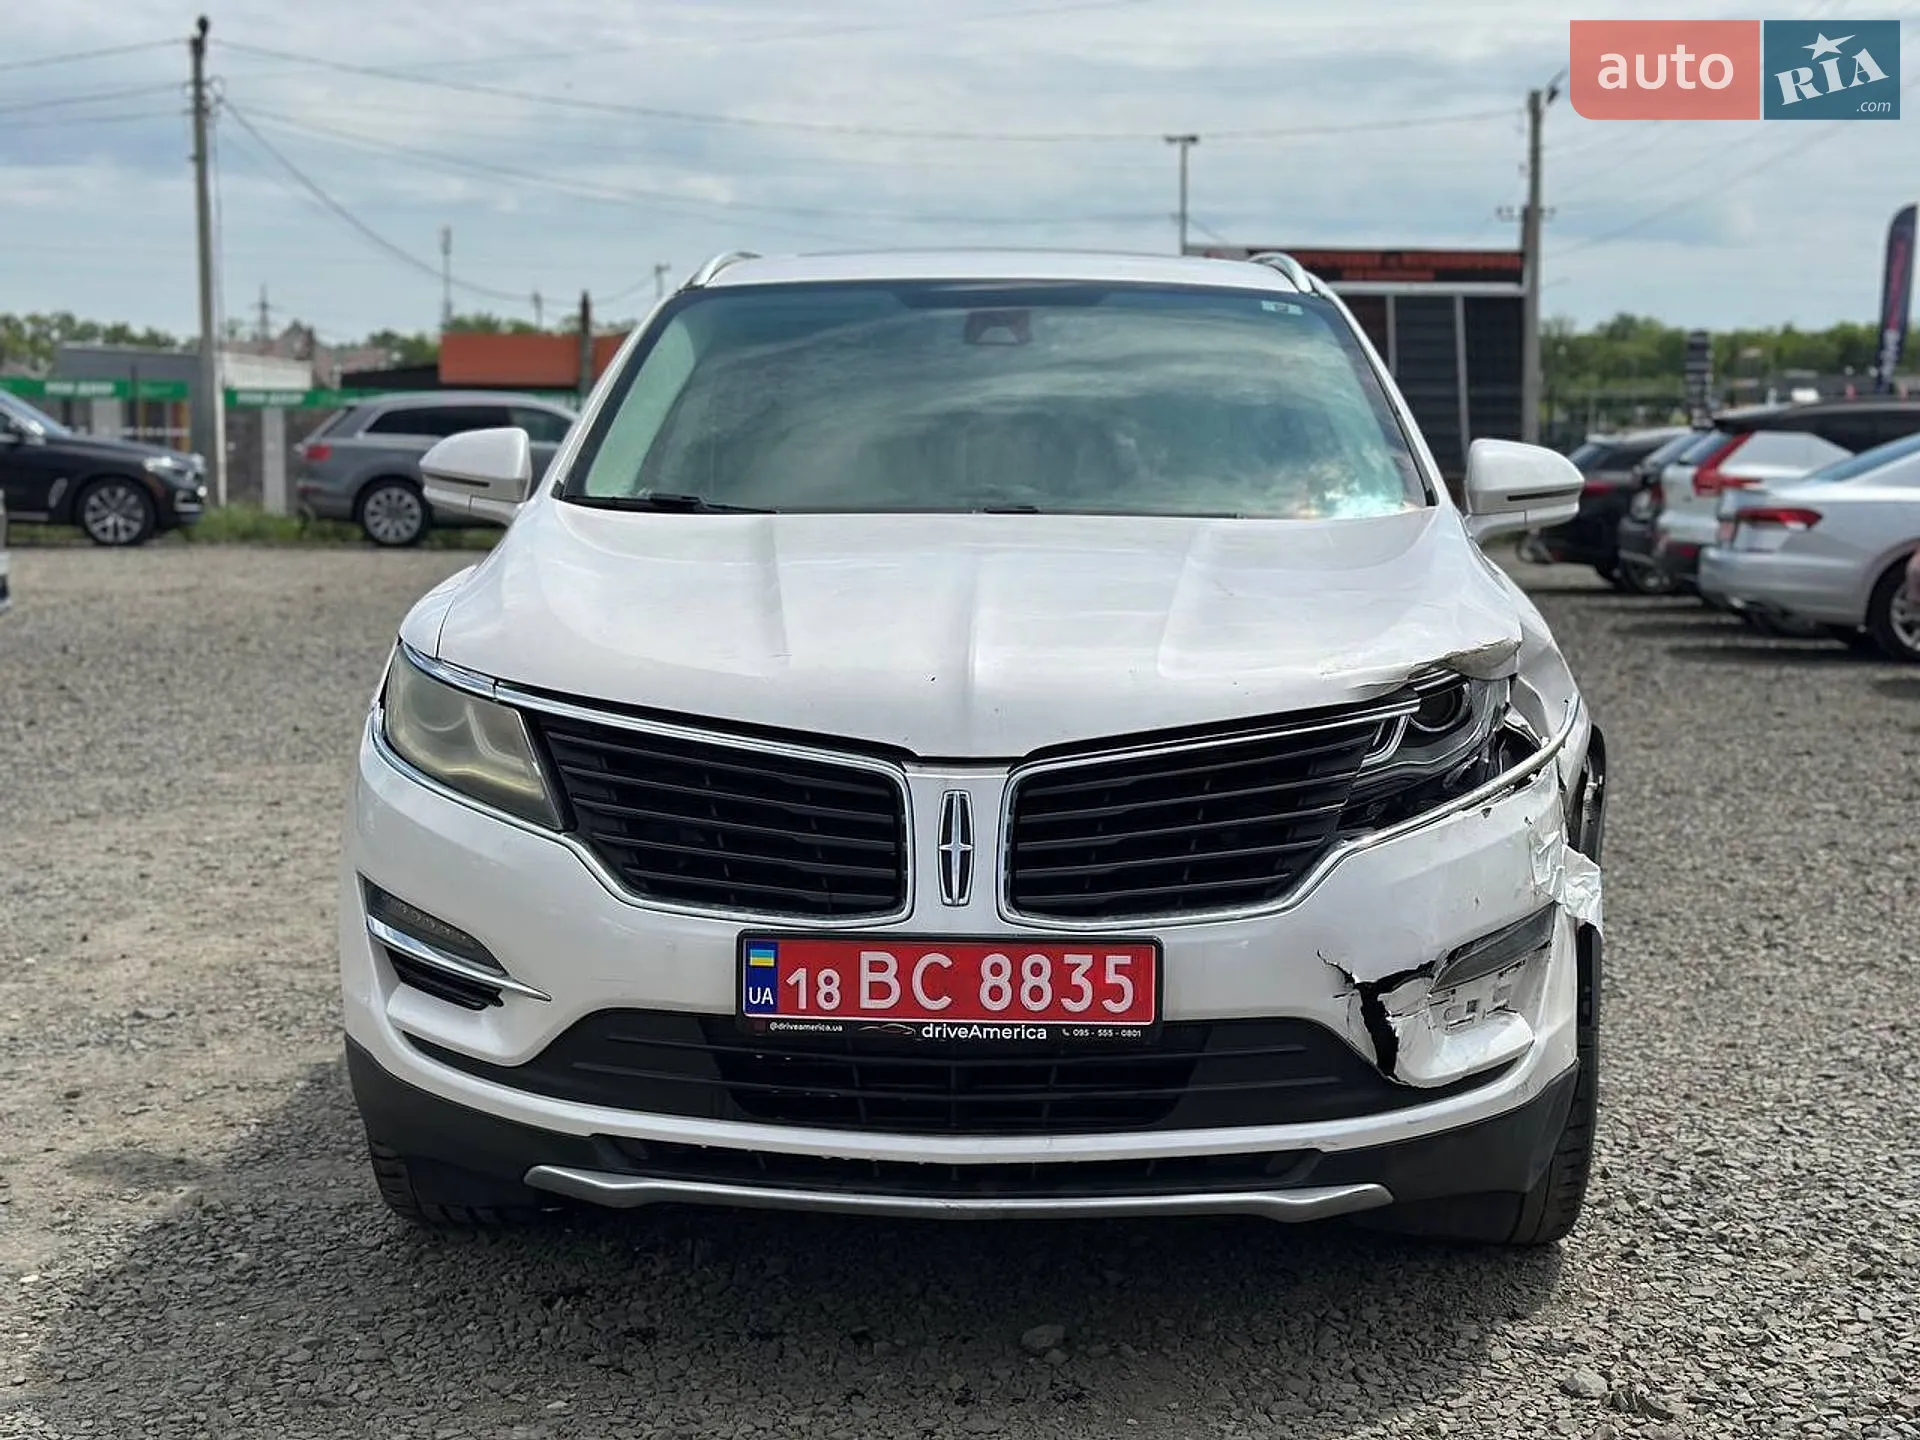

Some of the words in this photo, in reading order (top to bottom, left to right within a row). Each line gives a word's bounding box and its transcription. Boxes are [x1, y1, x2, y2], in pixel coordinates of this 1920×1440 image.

[786, 967, 841, 1010] 18
[859, 951, 952, 1010] BC
[979, 953, 1134, 1013] 8835
[749, 987, 773, 1005] UA
[921, 1022, 1047, 1041] driveAmerica
